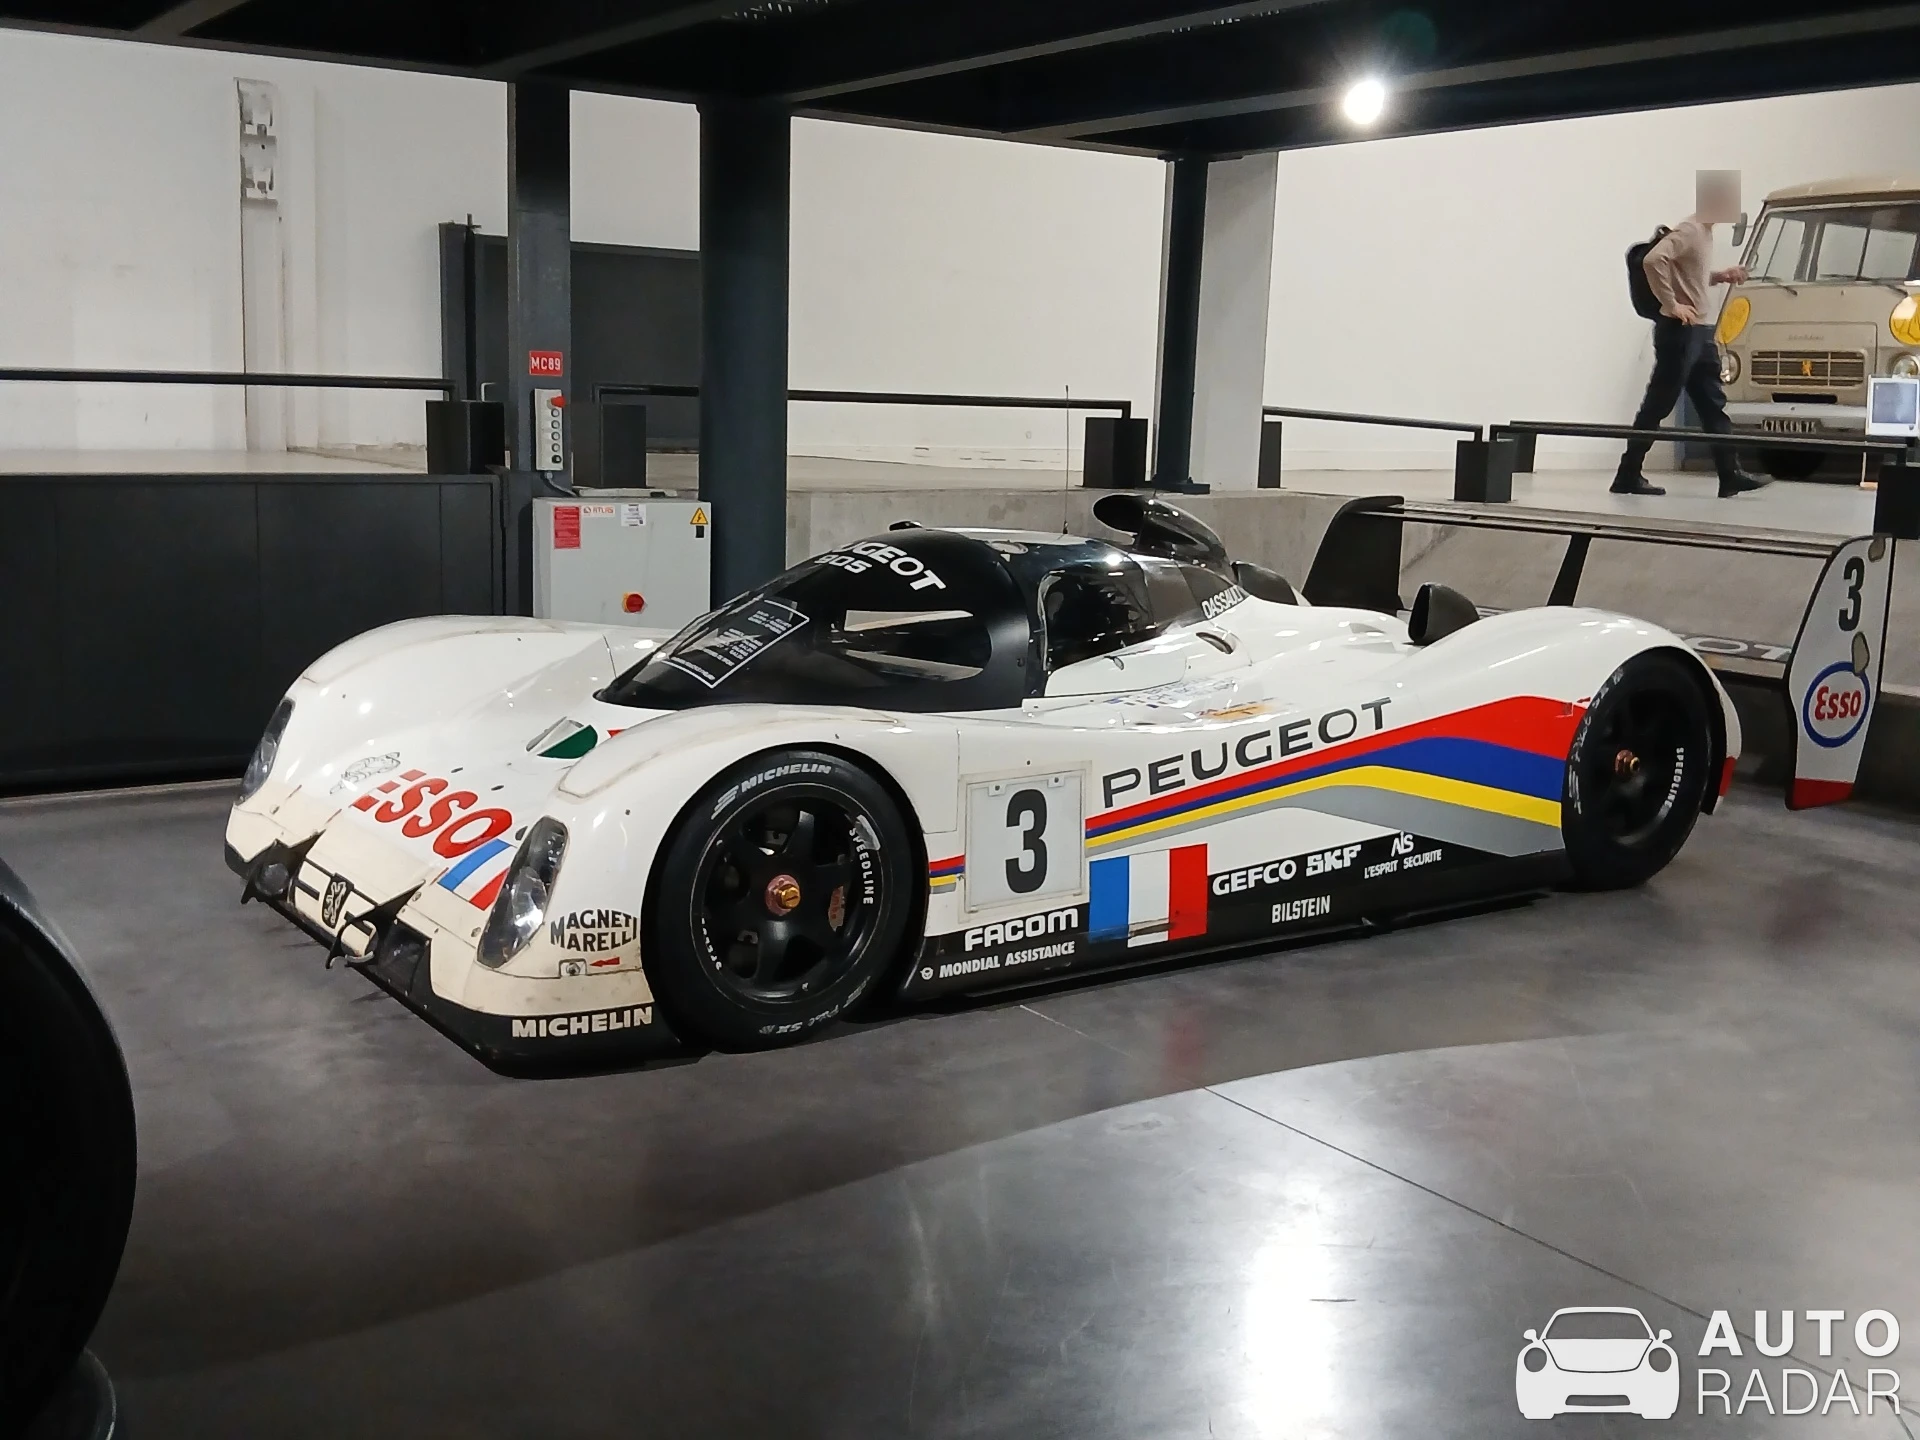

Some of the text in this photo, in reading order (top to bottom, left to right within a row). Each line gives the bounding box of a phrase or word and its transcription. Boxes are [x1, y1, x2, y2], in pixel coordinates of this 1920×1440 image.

[531, 356, 561, 371] MC89
[814, 554, 873, 574] 905
[1838, 555, 1865, 632] 3
[1102, 696, 1392, 809] PEUGEOT
[741, 763, 832, 793] MICHELIN
[1663, 747, 1685, 809] SPEEDLINE
[1004, 788, 1048, 894] 3
[849, 827, 875, 906] SPEEDLINE
[1212, 844, 1362, 896] GEFCO SKF
[1364, 848, 1443, 880] L'ESPRIT SECURITE
[551, 909, 638, 936] MAGNETI
[1271, 894, 1331, 924] BILSTEIN
[551, 927, 638, 952] MARELLI
[964, 907, 1079, 952] FACOM
[938, 941, 1075, 979] MONDIAL ASSISTANCE
[511, 1005, 653, 1039] MICHELIN
